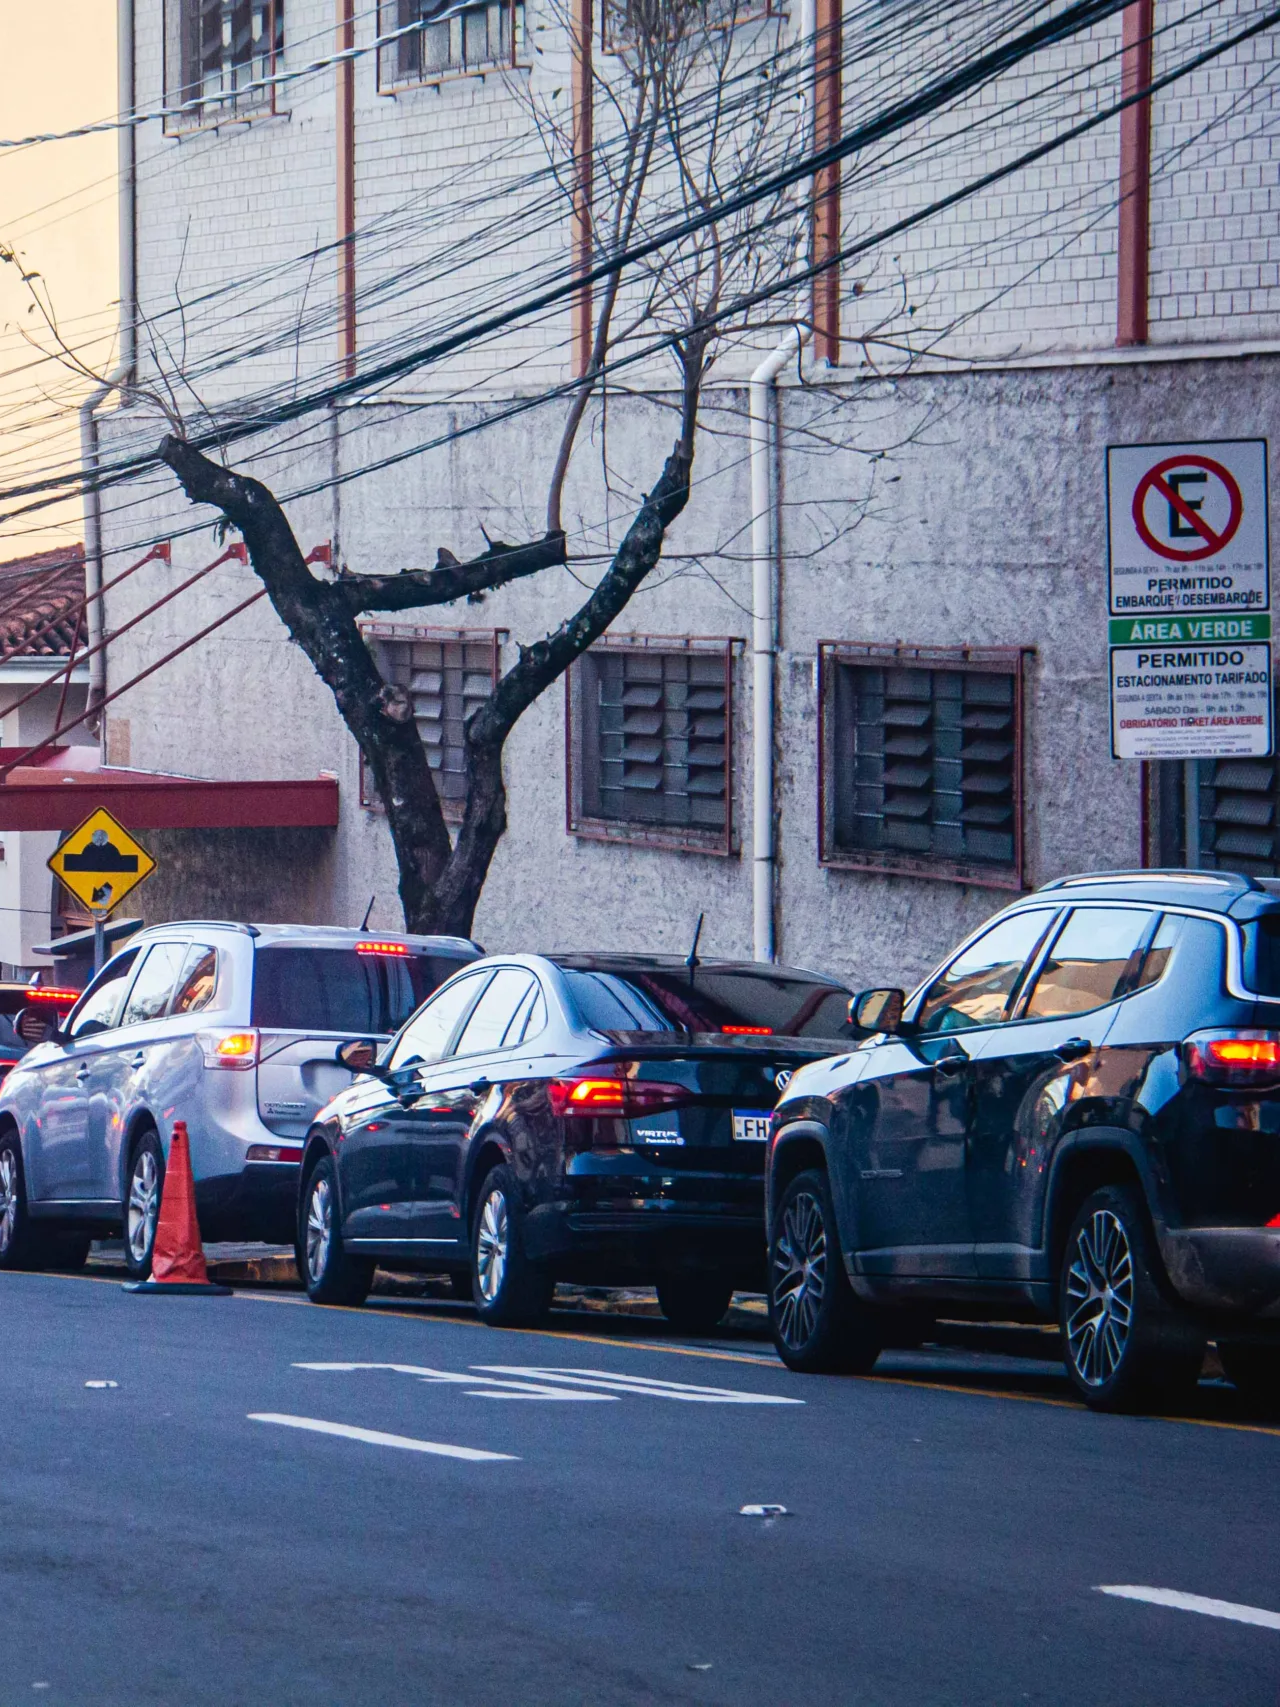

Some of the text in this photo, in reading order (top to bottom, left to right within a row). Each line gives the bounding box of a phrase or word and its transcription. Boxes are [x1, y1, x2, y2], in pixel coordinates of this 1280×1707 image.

[1169, 472, 1208, 538] E
[1148, 577, 1233, 592] PERMITIDO
[1116, 594, 1174, 608] EMBARQUE
[1182, 591, 1262, 606] DESEMBARQUE
[1130, 620, 1253, 641] ÁREA VERDE
[1138, 651, 1244, 668] PERMITIDO
[1117, 671, 1268, 688] ESTACIONAMENTO TARIFADO
[1120, 717, 1178, 729] OBRIGATÓRIO
[1210, 715, 1235, 726] ÁREA
[1235, 715, 1264, 726] VERDE
[637, 1130, 678, 1138] VIRTUS
[744, 1119, 767, 1138] FH
